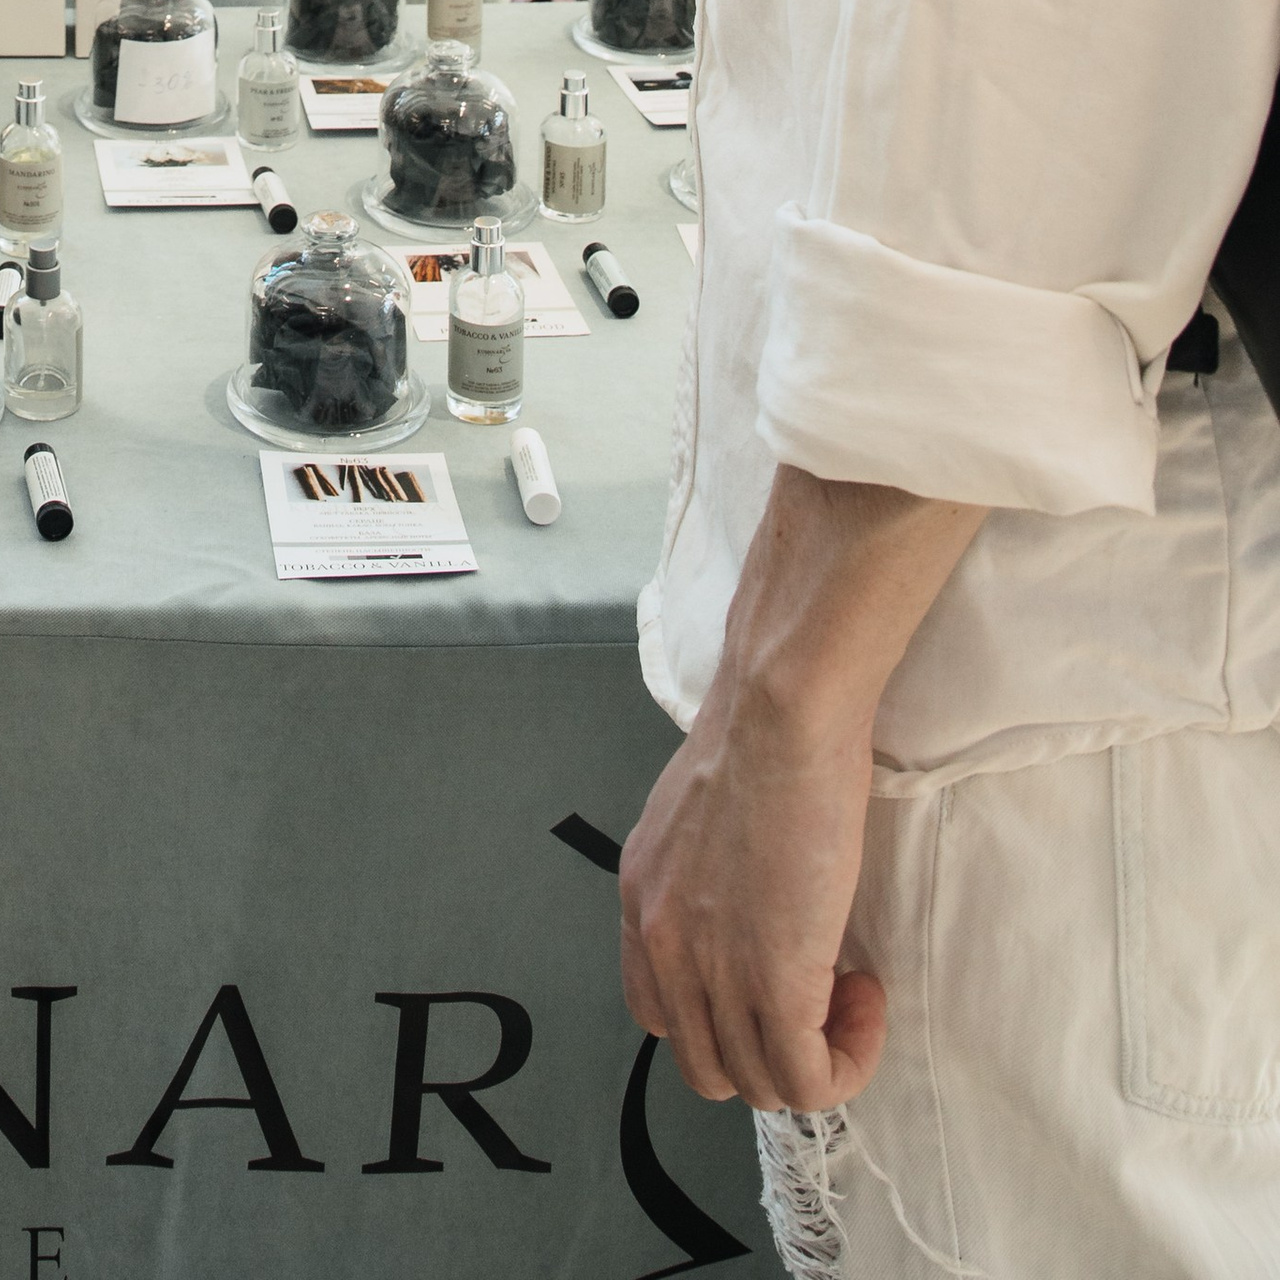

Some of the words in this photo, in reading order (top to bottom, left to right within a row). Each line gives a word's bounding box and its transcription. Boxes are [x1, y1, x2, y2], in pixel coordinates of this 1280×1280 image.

[453, 324, 489, 340] TOBACCO
[280, 563, 365, 571] TOBACCO
[388, 560, 471, 568] VANILLA
